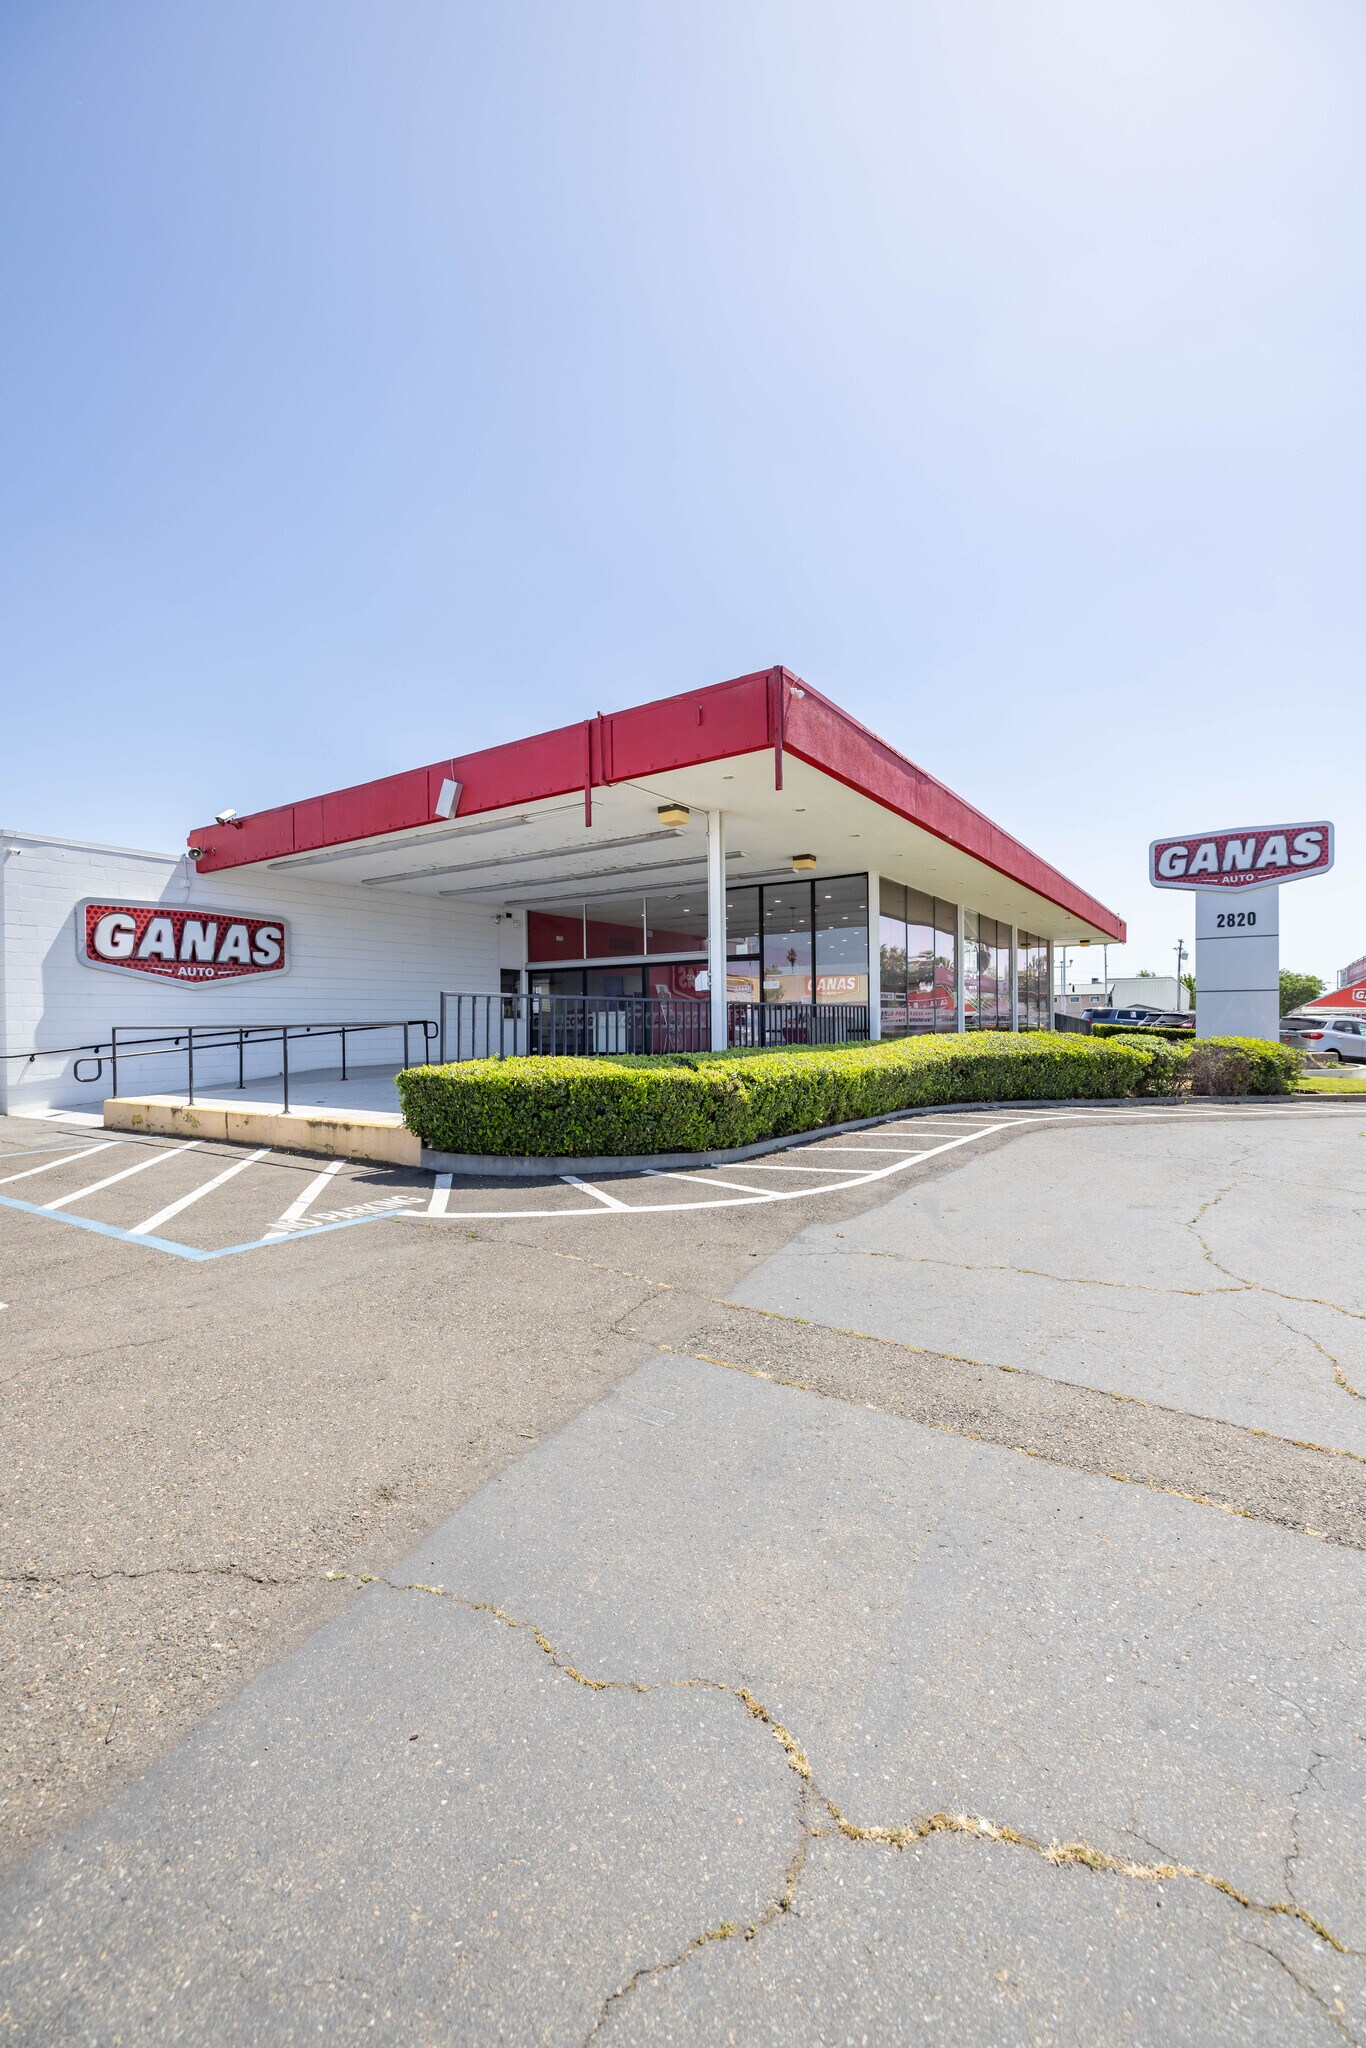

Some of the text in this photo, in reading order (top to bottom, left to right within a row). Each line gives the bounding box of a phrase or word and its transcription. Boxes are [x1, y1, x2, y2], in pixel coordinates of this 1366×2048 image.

[1158, 831, 1324, 877] GANAS
[1221, 874, 1255, 884] AUTO
[1216, 911, 1257, 928] 2820
[94, 911, 282, 966] GANAS
[177, 966, 215, 977] AUTO
[266, 1195, 427, 1232] NO PARKING
